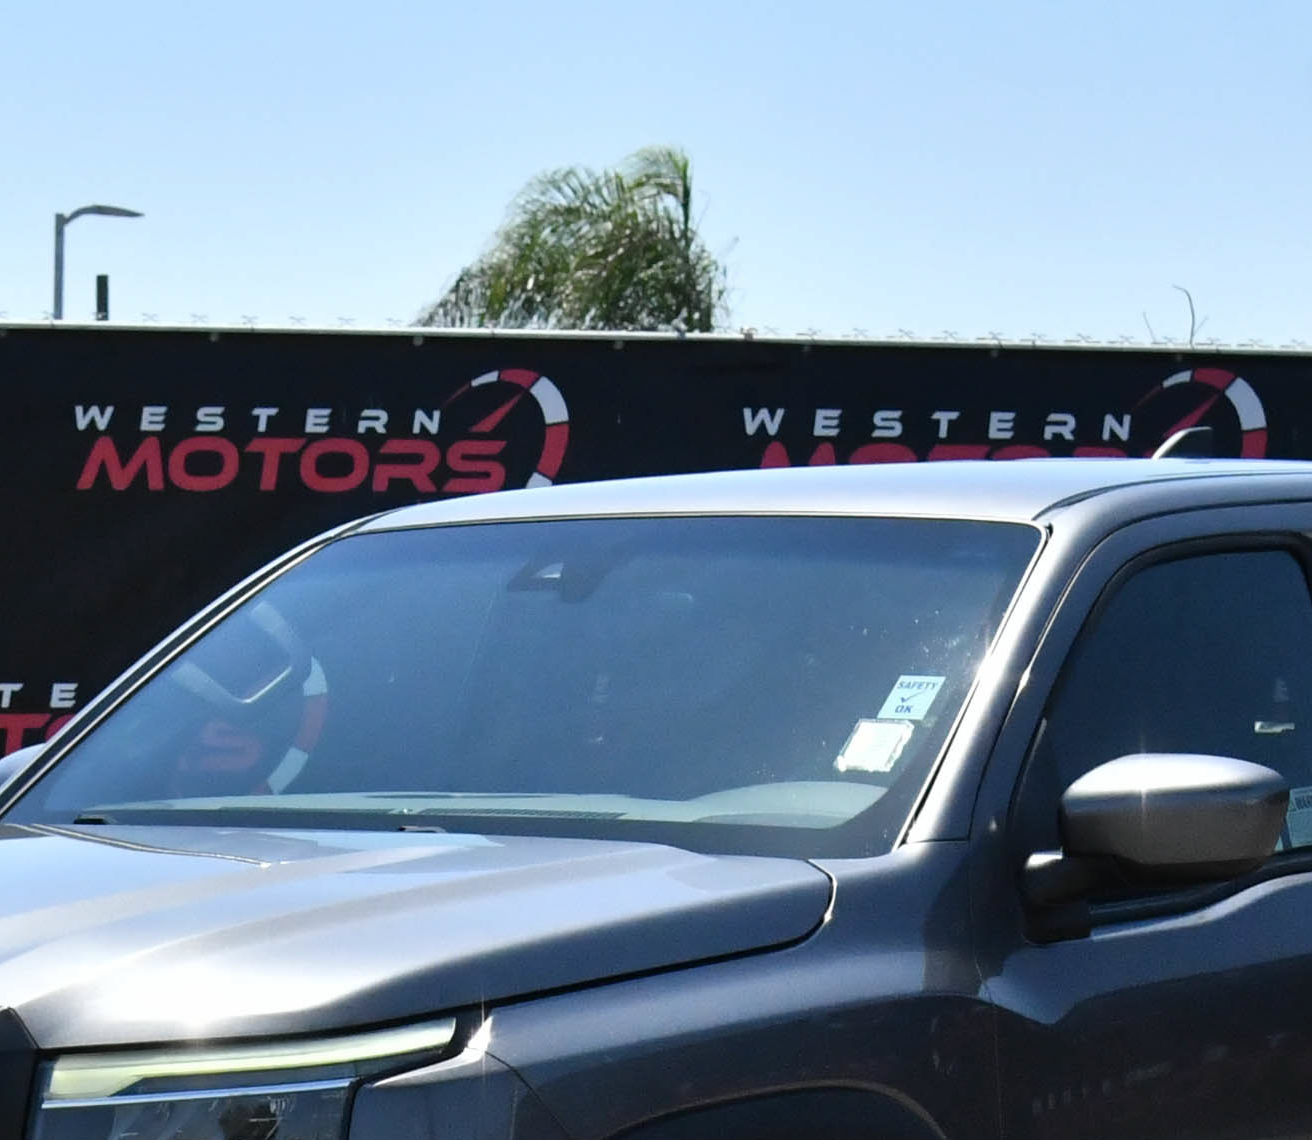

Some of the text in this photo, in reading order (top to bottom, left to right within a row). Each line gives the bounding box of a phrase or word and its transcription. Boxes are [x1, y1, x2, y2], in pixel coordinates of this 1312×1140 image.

[74, 406, 442, 435] WESTERN
[743, 407, 1132, 442] WESTERN
[76, 436, 507, 493] MOTORS
[897, 680, 938, 690] SAFETY
[894, 705, 913, 714] OK
